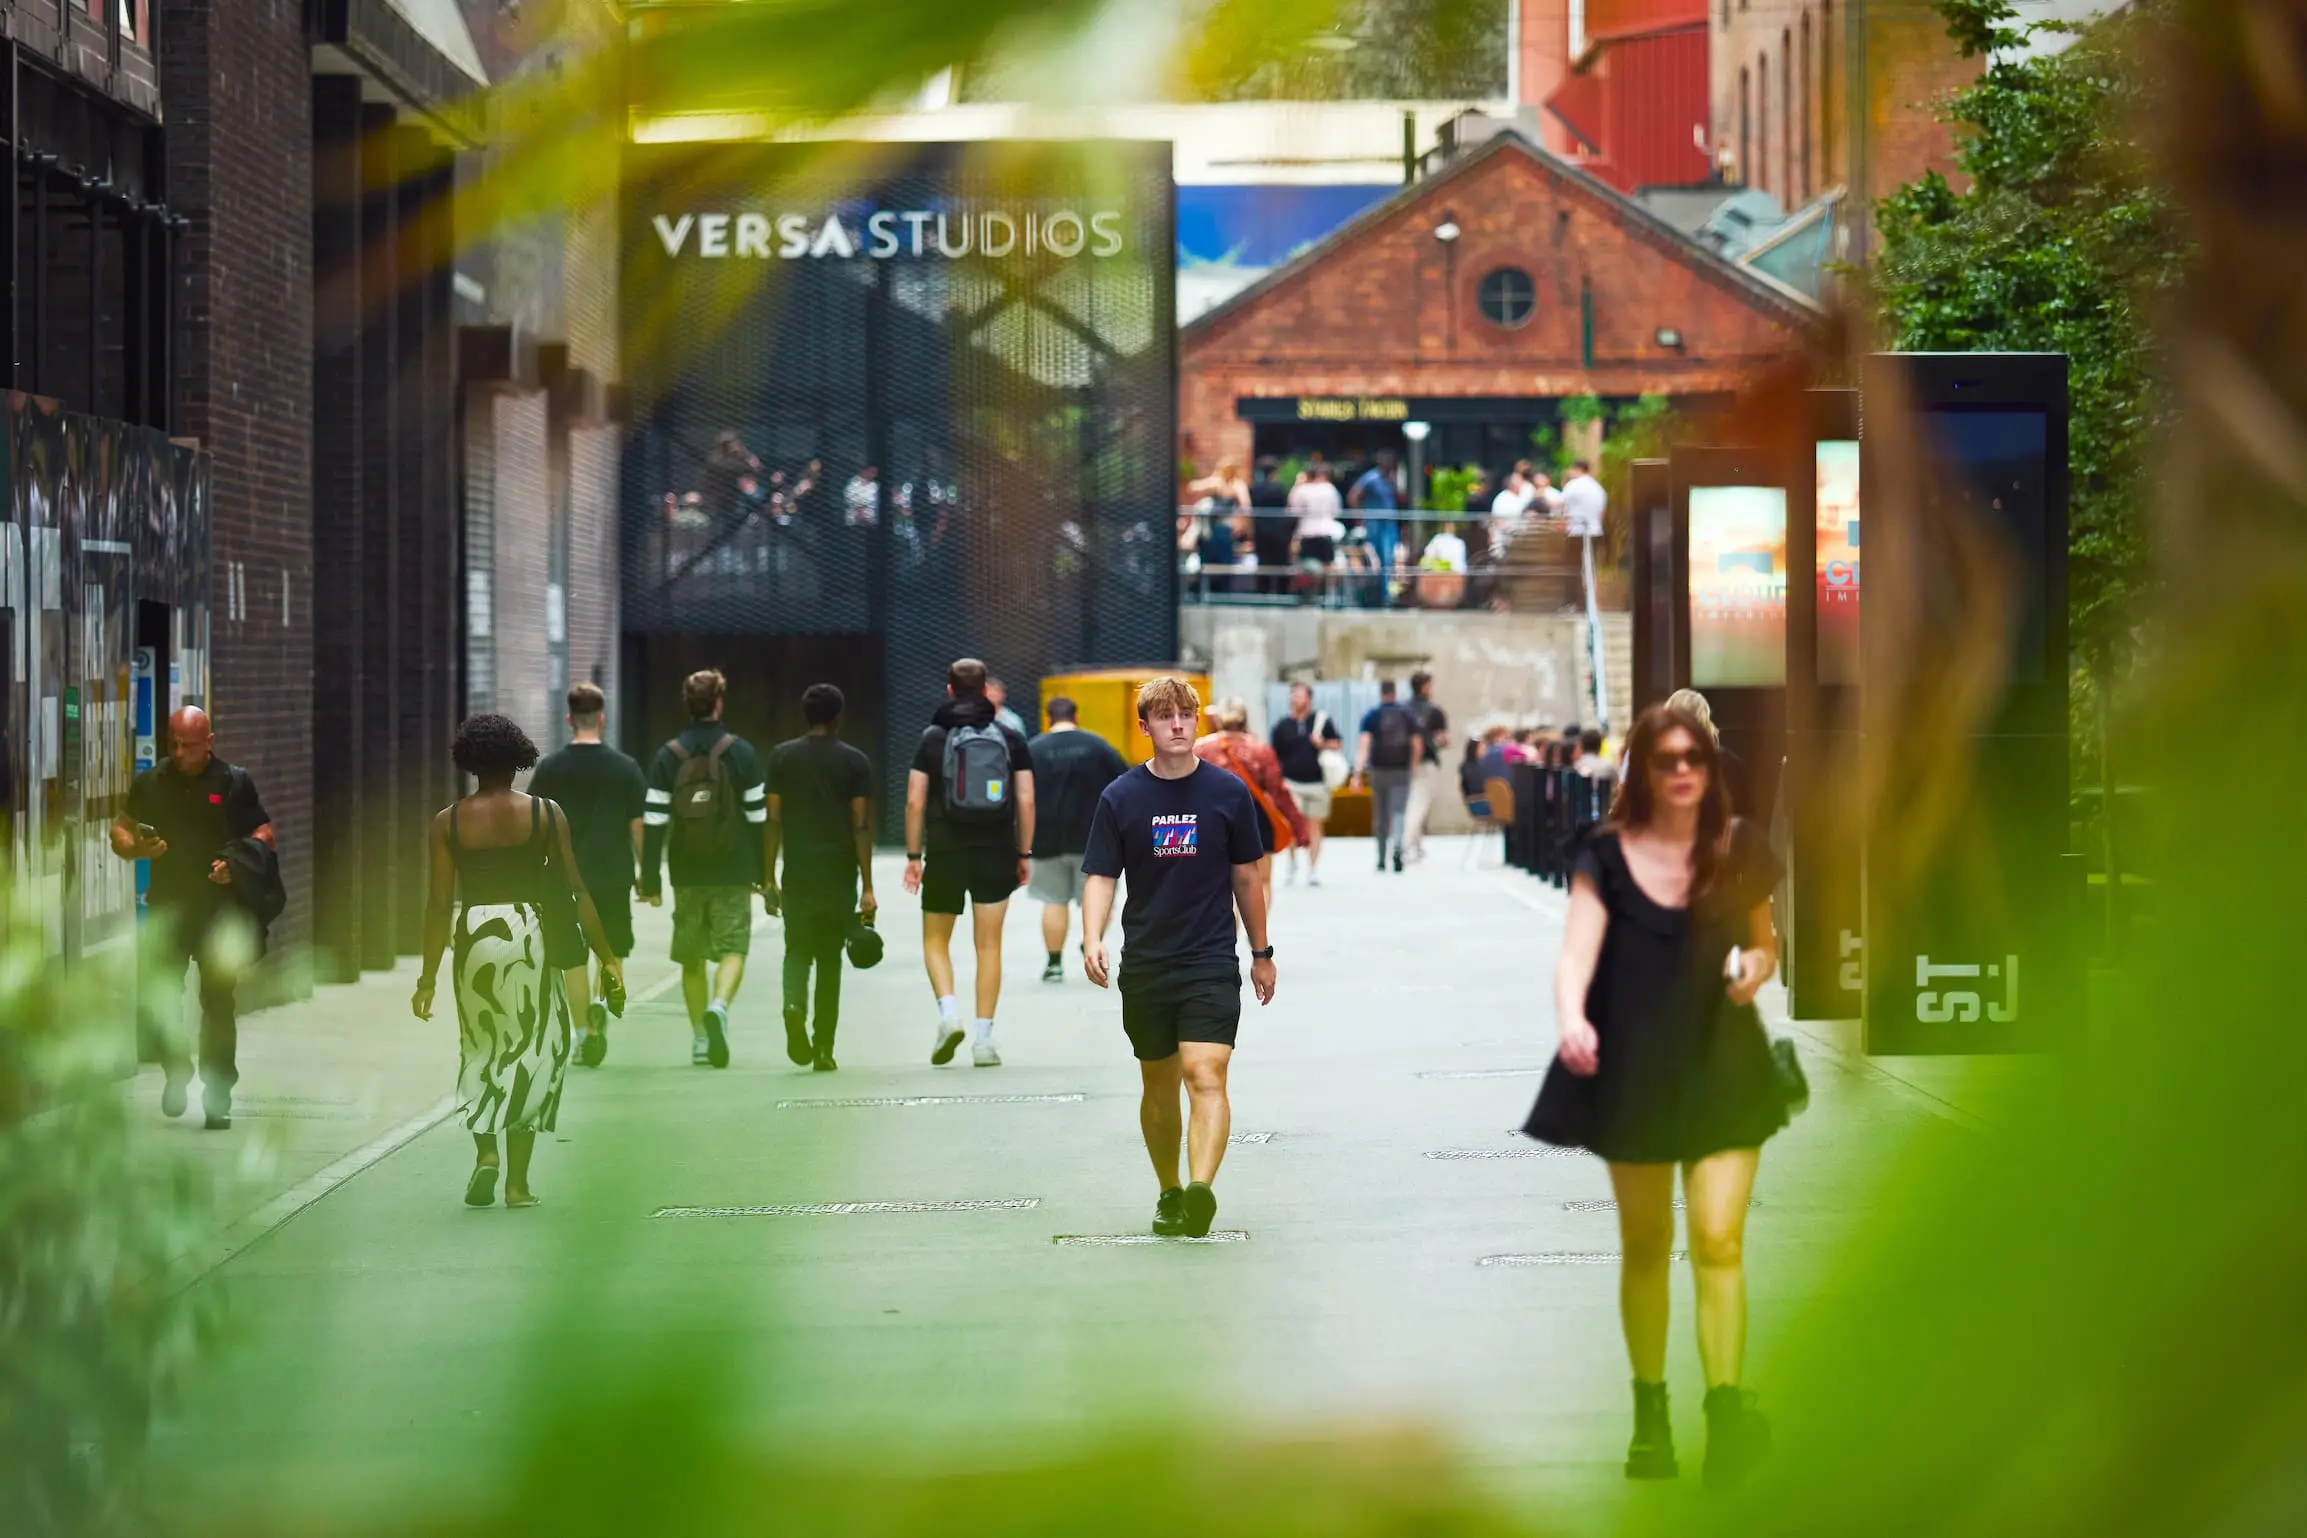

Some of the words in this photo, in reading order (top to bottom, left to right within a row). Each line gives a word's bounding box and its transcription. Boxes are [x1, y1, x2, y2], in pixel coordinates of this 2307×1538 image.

[652, 212, 853, 259] VERSA
[868, 211, 1124, 259] STUDIOS
[1152, 815, 1197, 826] PARLEZ
[1153, 845, 1197, 857] SportsClub
